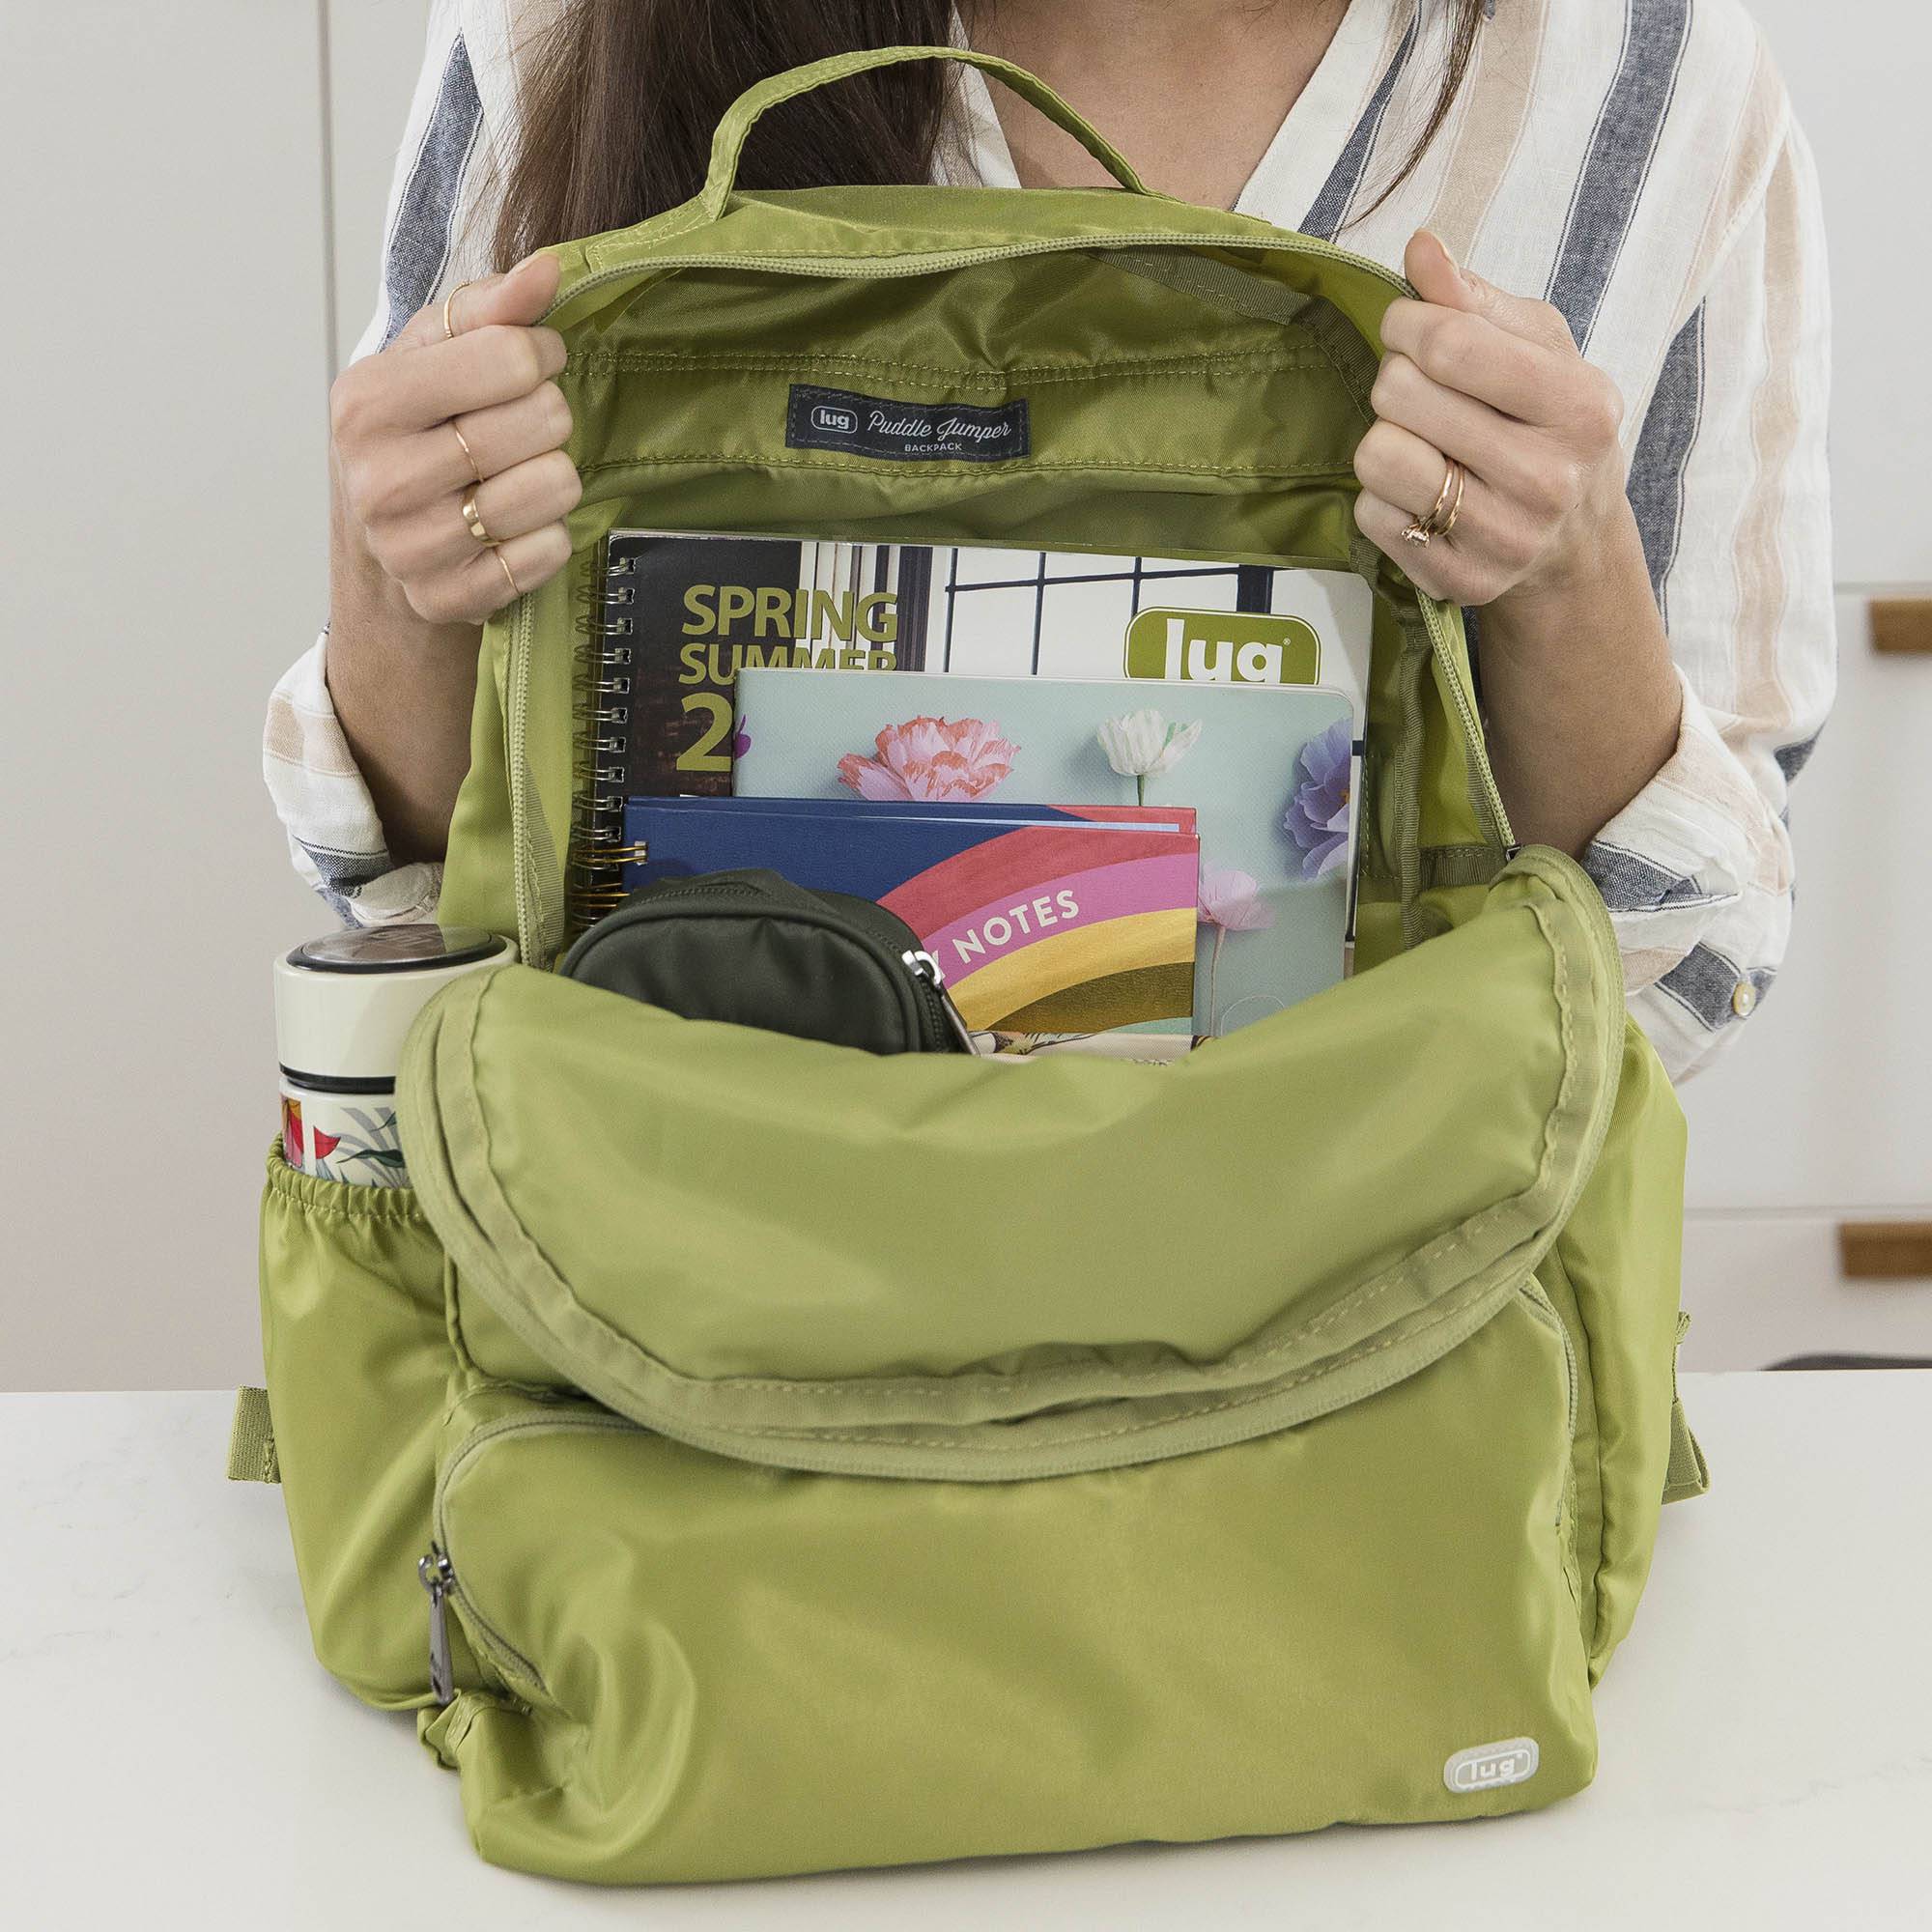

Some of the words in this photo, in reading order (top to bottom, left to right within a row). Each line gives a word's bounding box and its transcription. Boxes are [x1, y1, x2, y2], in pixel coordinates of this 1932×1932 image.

[819, 410, 850, 430] lug
[867, 410, 932, 437] Puddle
[937, 416, 1012, 443] Jumper
[904, 441, 962, 453] BACKPACK
[680, 584, 898, 643] SPRING
[952, 890, 1079, 964] NOTES
[1471, 1758, 1515, 1780] lug
